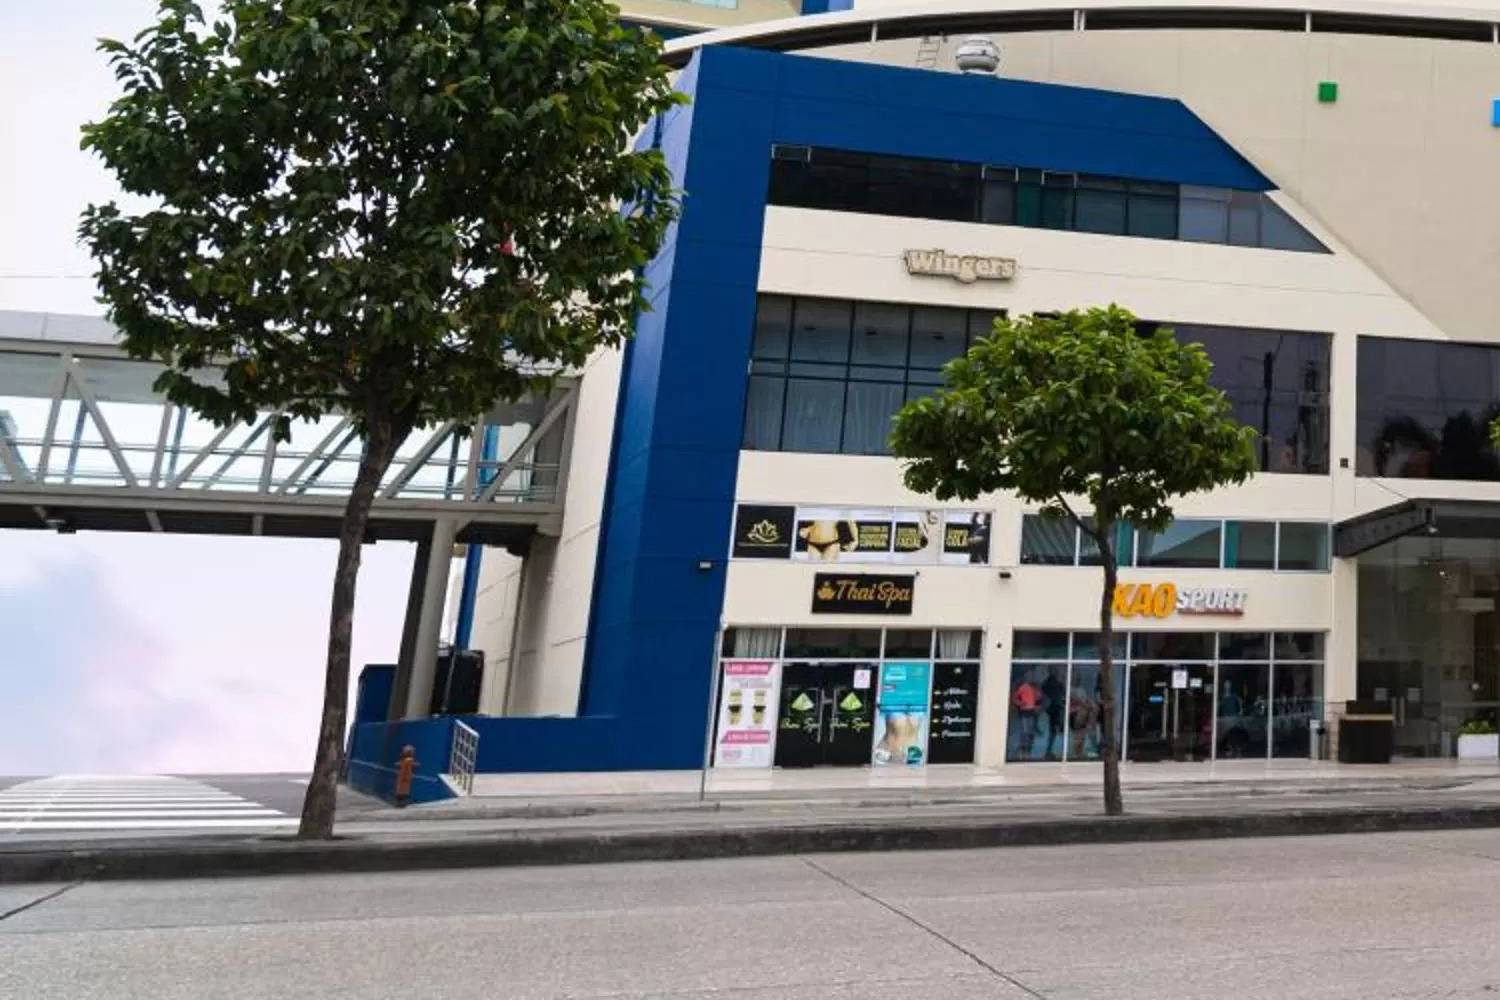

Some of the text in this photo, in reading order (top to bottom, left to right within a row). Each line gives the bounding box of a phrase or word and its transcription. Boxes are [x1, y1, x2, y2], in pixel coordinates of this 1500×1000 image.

[903, 247, 1016, 284] Wingers
[835, 579, 911, 609] Thai Spa
[1112, 582, 1248, 619] KAO SPORT
